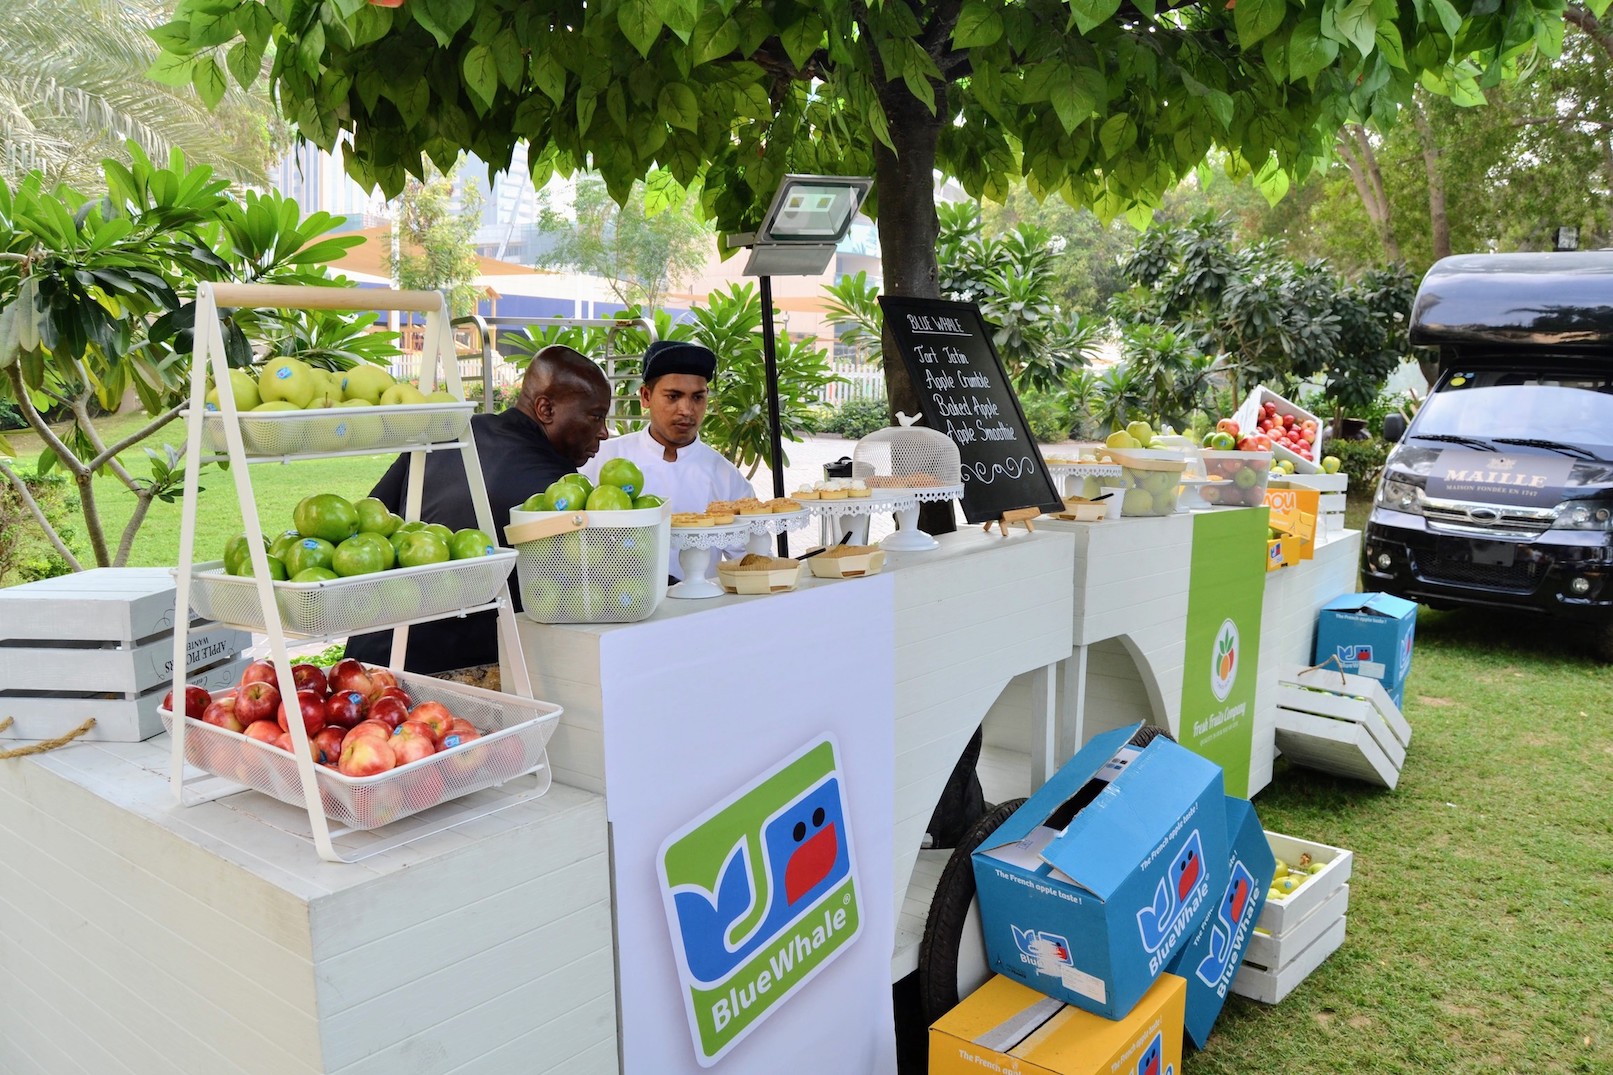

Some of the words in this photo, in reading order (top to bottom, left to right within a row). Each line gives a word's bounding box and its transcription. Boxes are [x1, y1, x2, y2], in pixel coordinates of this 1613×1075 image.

[907, 314, 933, 330] BLUE
[931, 316, 964, 332] WHALE
[914, 345, 938, 363] Tart
[942, 346, 969, 364] Tatin
[925, 369, 955, 391] Apple
[957, 369, 991, 389] Crumble
[933, 393, 972, 416] Baked
[972, 396, 999, 419] Apple
[946, 419, 977, 445] Apple
[976, 419, 1017, 441] Smoothie
[1444, 469, 1547, 489] MAILLE
[186, 637, 209, 651] WANTE
[201, 640, 227, 660] APPLE
[1141, 857, 1151, 871] The
[1151, 837, 1169, 860] French
[1169, 820, 1183, 840] apple
[1183, 806, 1196, 824] taste
[995, 869, 1009, 881] The
[1010, 874, 1035, 889] French
[1035, 884, 1057, 898] apple
[1058, 890, 1079, 904] taste
[959, 1049, 974, 1062] The
[974, 1055, 1001, 1072] French
